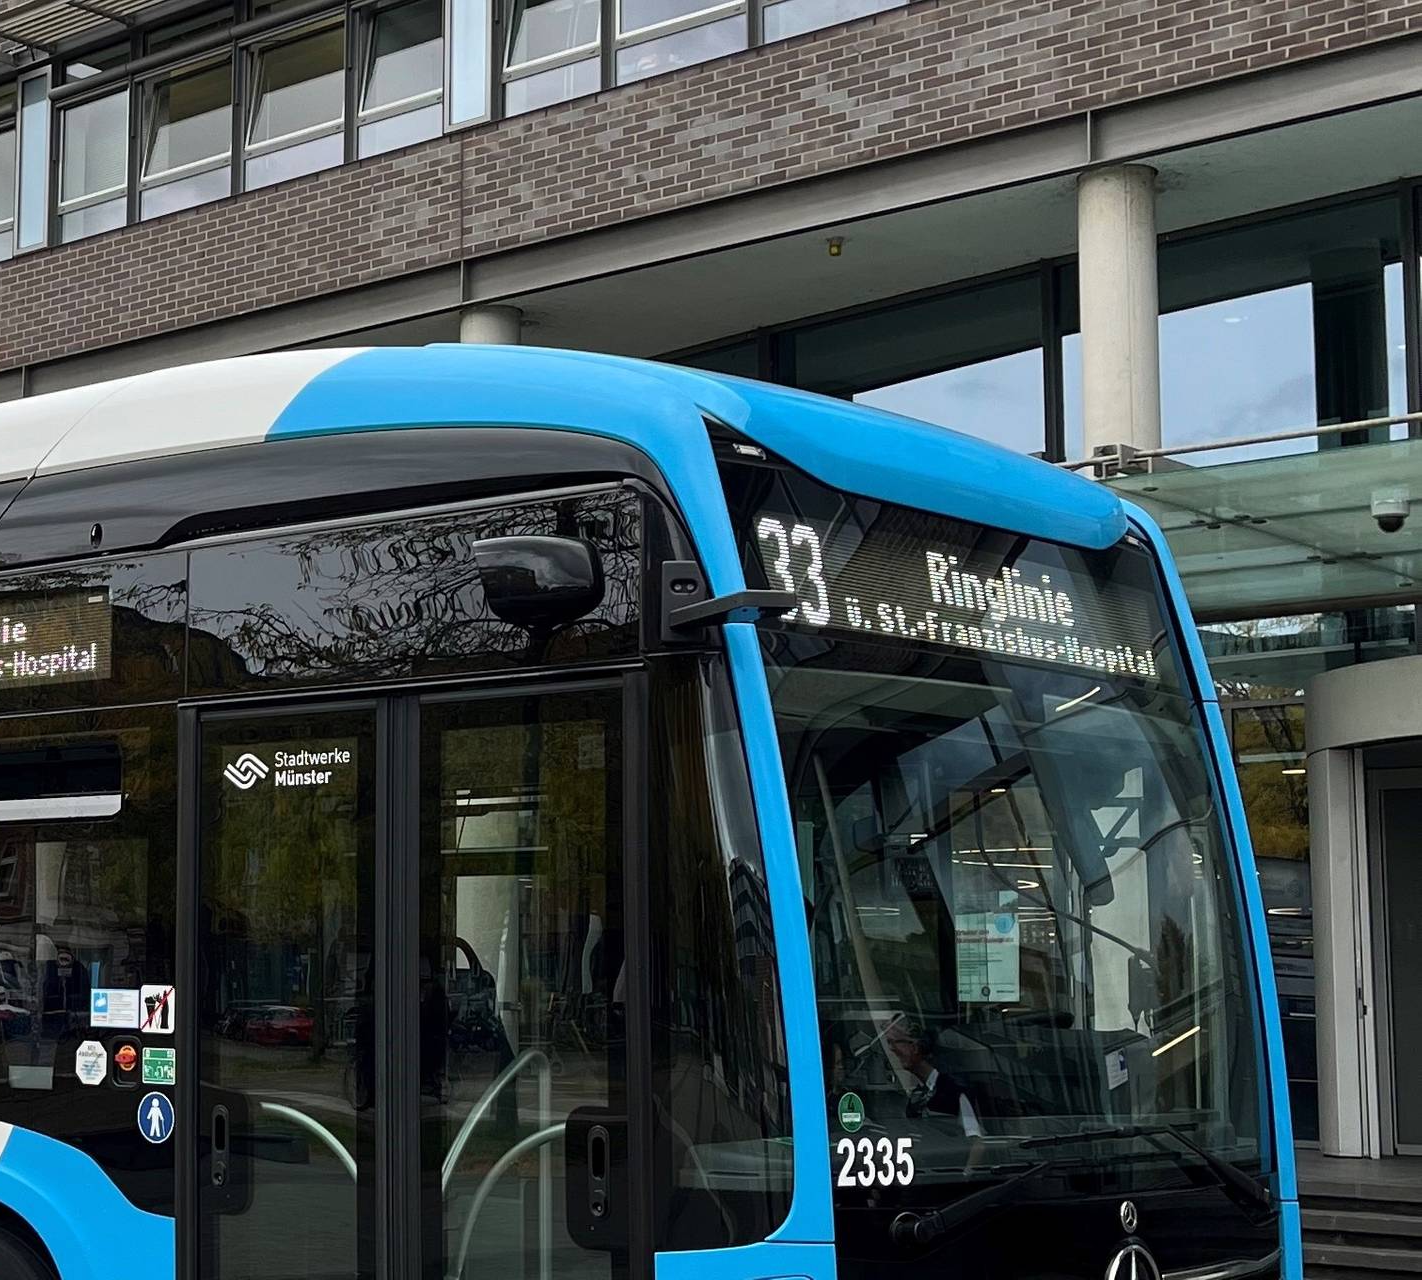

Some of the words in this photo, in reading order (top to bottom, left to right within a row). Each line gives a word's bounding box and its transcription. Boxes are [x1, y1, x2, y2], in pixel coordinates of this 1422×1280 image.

[758, 517, 831, 626] 33
[925, 550, 1075, 627] Ringlinie
[877, 602, 1157, 676] St.-Franziskus-Hospital
[274, 747, 351, 768] Stadtwerke
[274, 769, 332, 786] Münster
[837, 1137, 915, 1187] 2335
